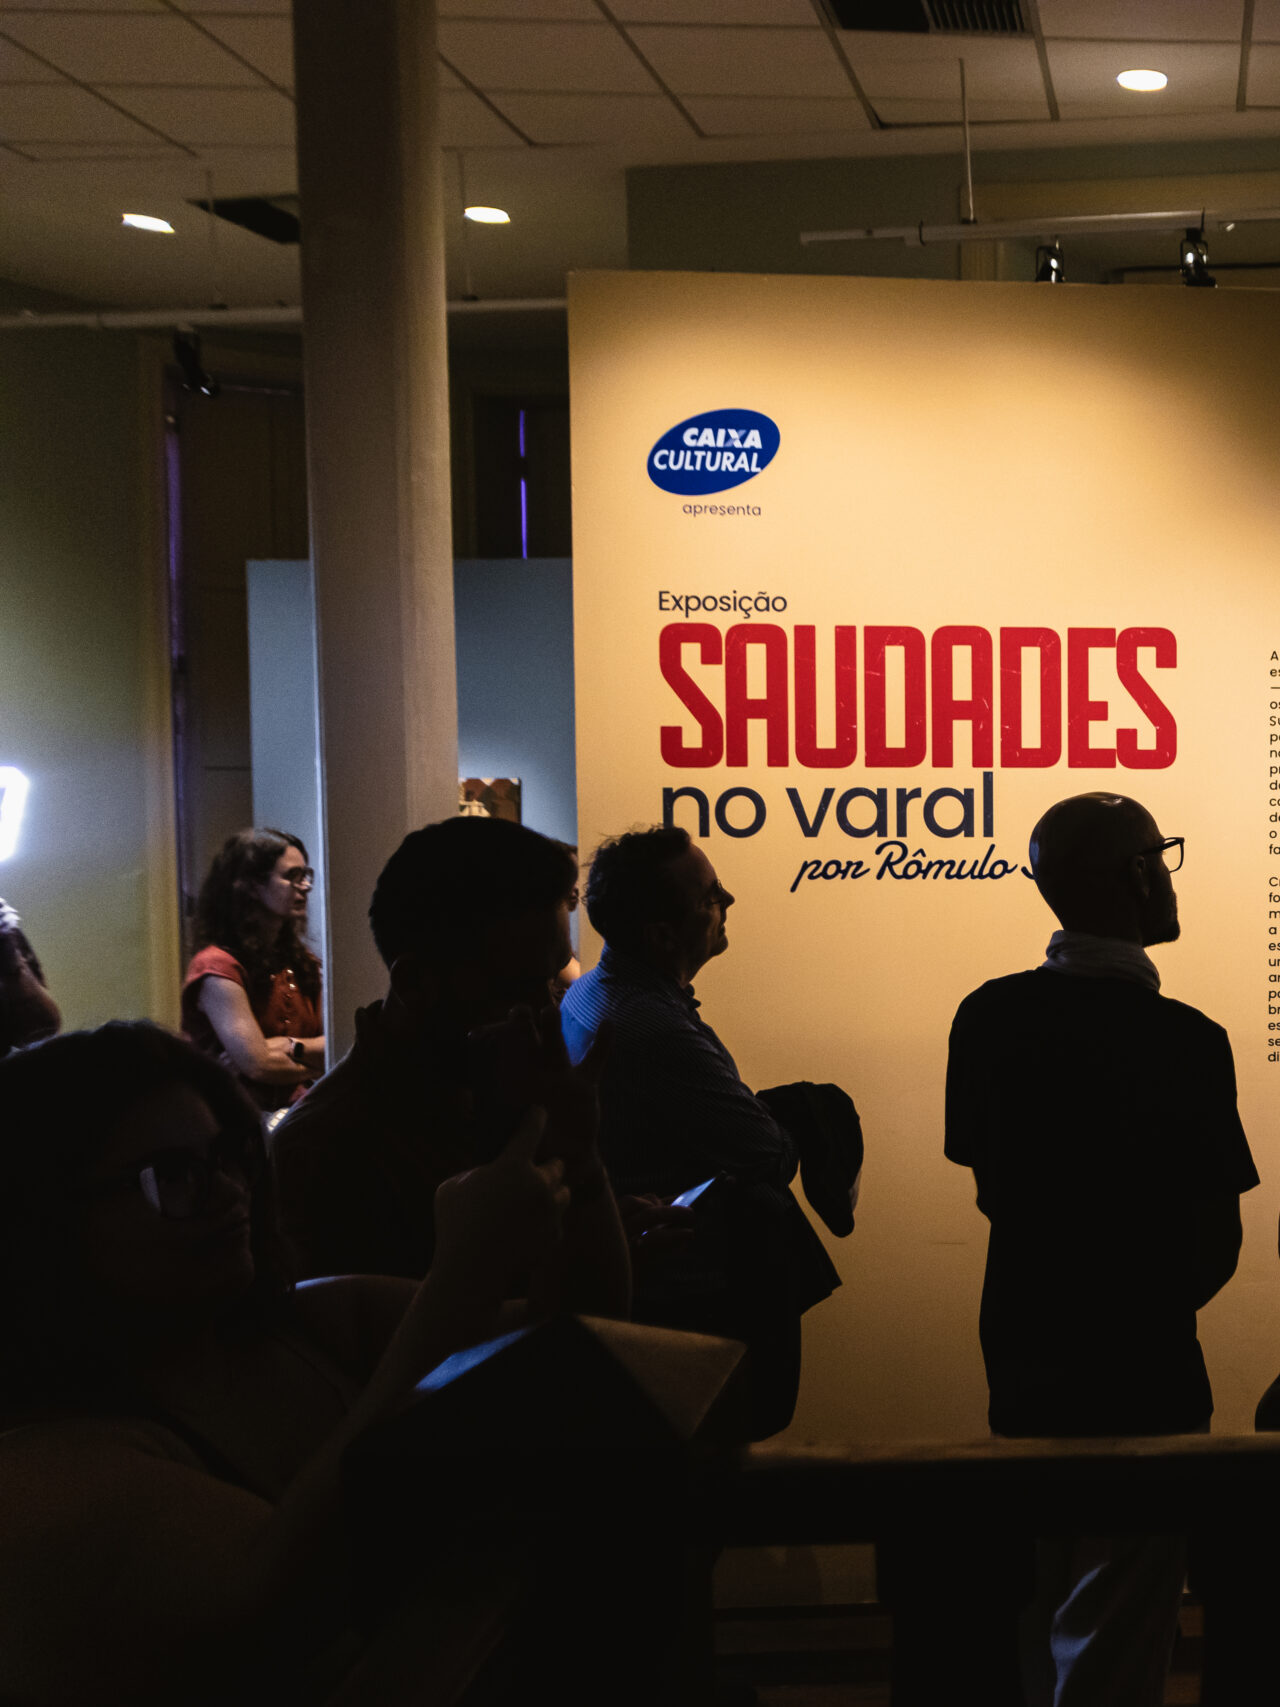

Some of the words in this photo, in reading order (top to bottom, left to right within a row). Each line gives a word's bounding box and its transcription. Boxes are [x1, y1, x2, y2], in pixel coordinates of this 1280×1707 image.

[682, 427, 762, 450] CAIXA
[653, 449, 762, 473] CULTURAL
[682, 502, 762, 518] apresenta
[658, 590, 788, 619] Exposição
[1270, 650, 1278, 661] A
[659, 622, 1178, 770] SAUDADES
[662, 786, 767, 839] no
[787, 771, 995, 839] varal
[790, 858, 870, 894] por
[875, 842, 1019, 881] Rômulo
